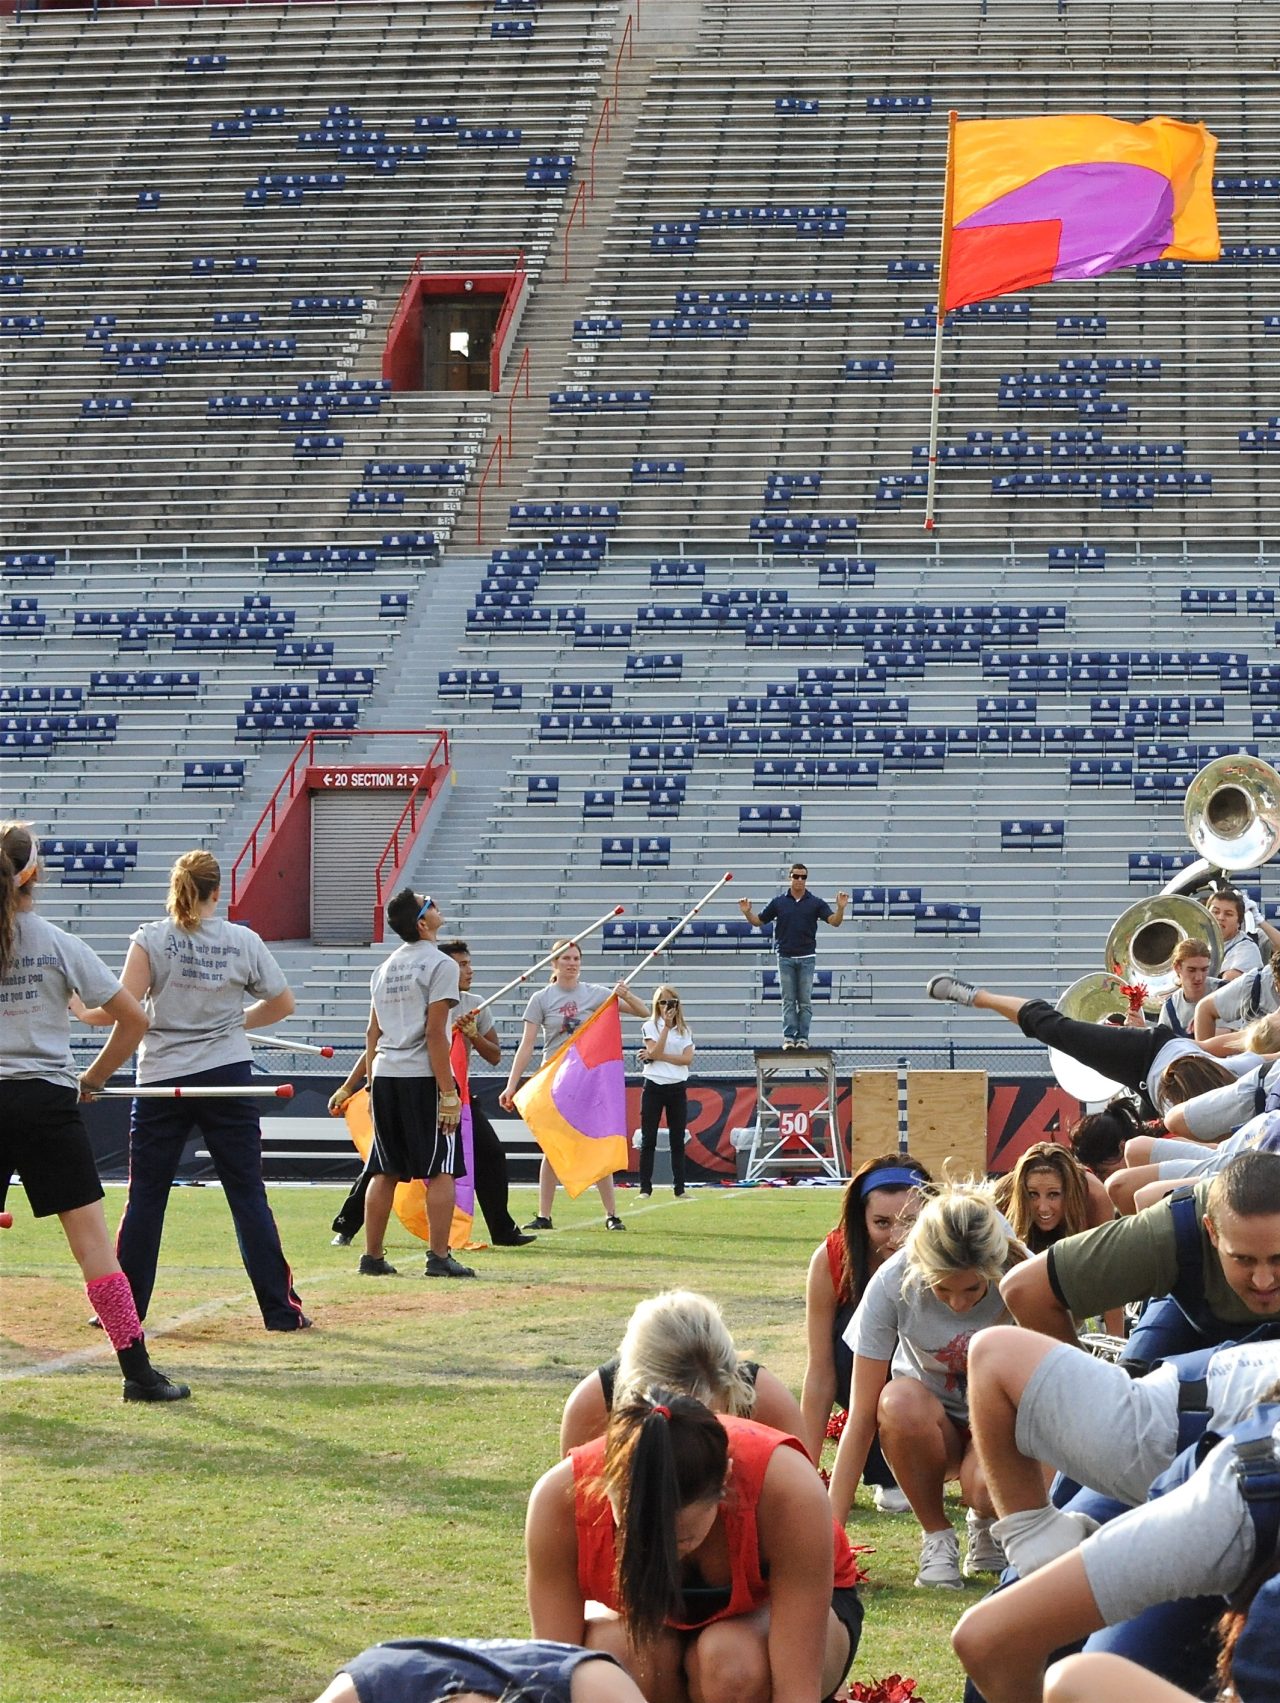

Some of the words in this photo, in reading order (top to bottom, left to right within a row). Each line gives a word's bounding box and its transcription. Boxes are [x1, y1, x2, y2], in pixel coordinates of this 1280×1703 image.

[335, 774, 348, 786] 20
[351, 773, 394, 787] SECTION
[397, 774, 408, 786] 21
[28, 973, 44, 985] you
[781, 1112, 808, 1135] 50
